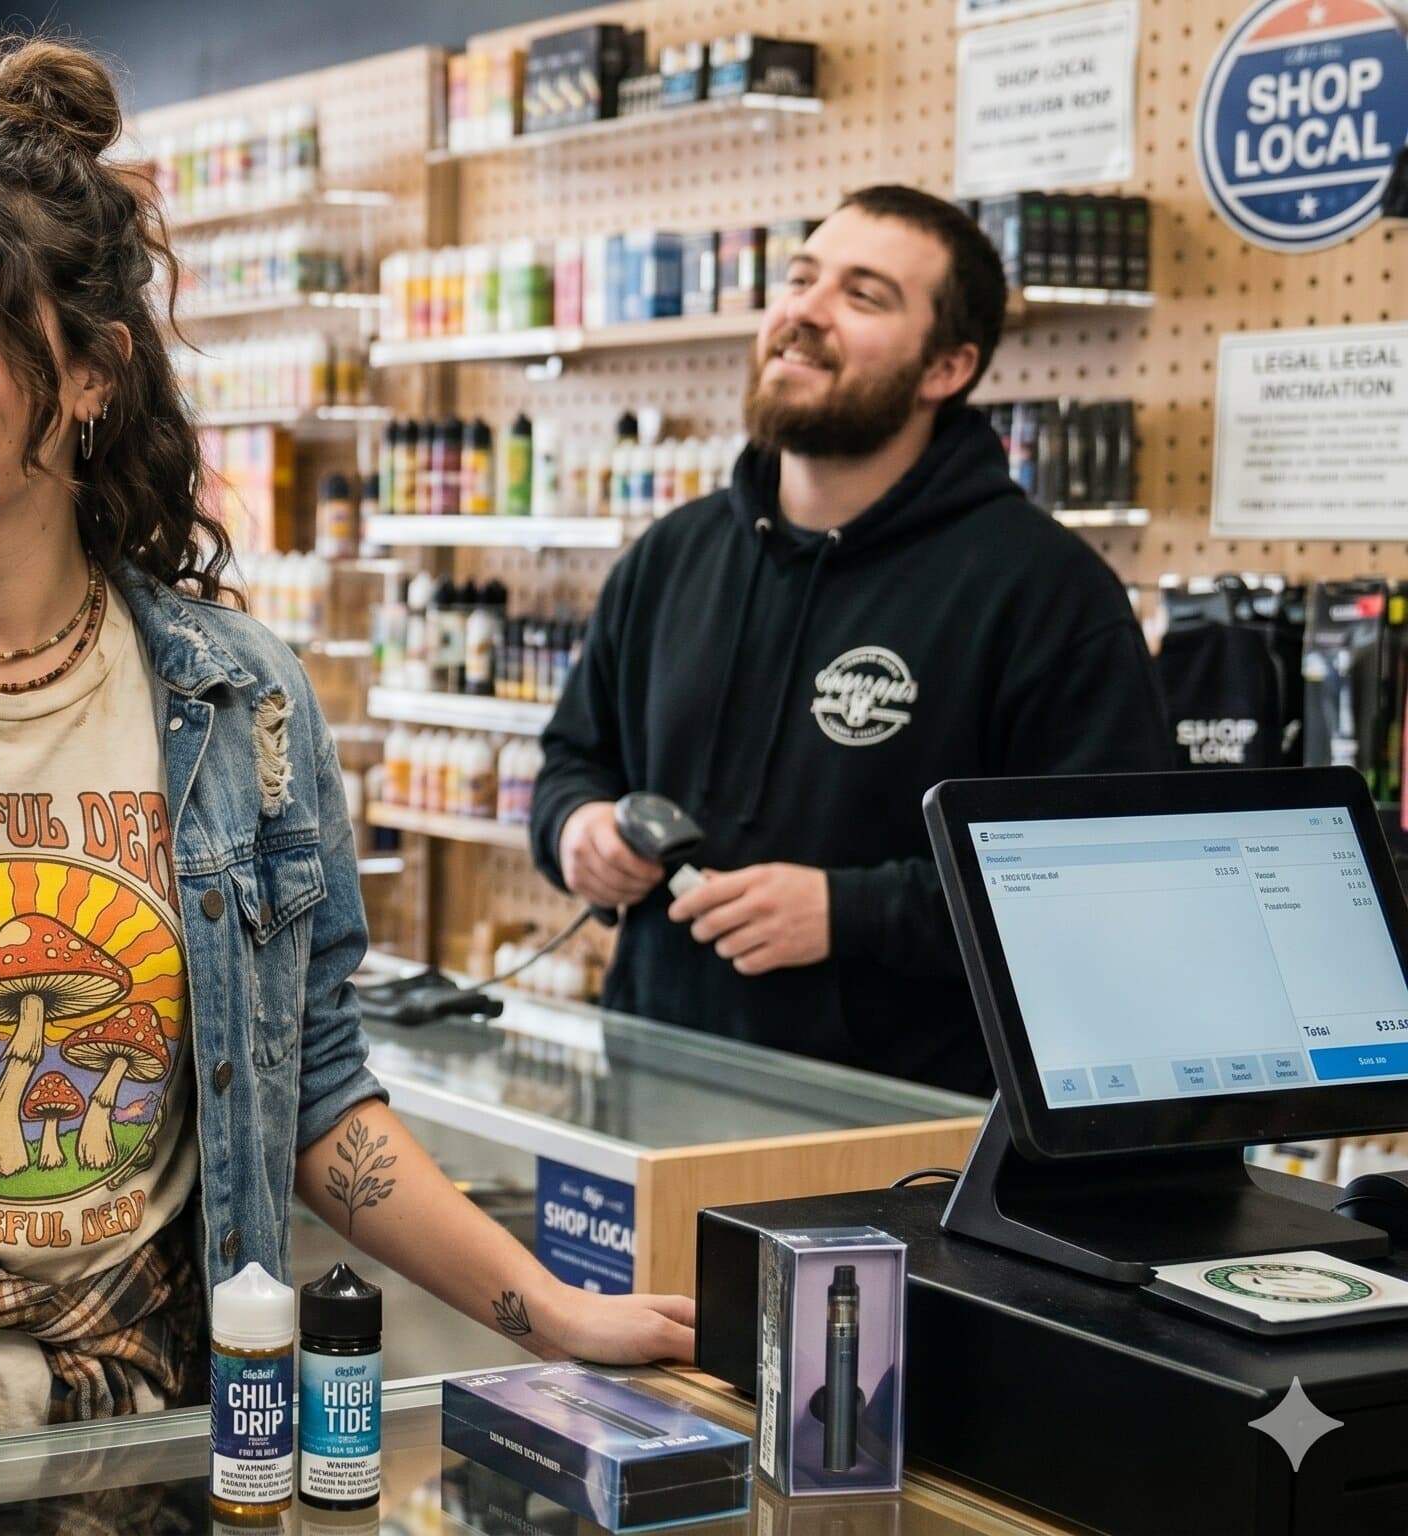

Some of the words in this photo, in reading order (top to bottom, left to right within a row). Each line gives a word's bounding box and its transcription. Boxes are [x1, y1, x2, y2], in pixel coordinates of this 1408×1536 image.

[1246, 57, 1384, 125] SHOP
[1234, 111, 1391, 178] LOCAL
[1252, 353, 1321, 376] LEGAL
[1329, 345, 1401, 371] LEGAL
[78, 791, 182, 920] DEA
[81, 1190, 146, 1245] DEAD
[544, 1201, 588, 1238] SHOP
[228, 1382, 287, 1409] CHILL
[323, 1379, 373, 1407] HIGH
[233, 1409, 284, 1436] DRIP
[324, 1406, 372, 1434] TIDE
